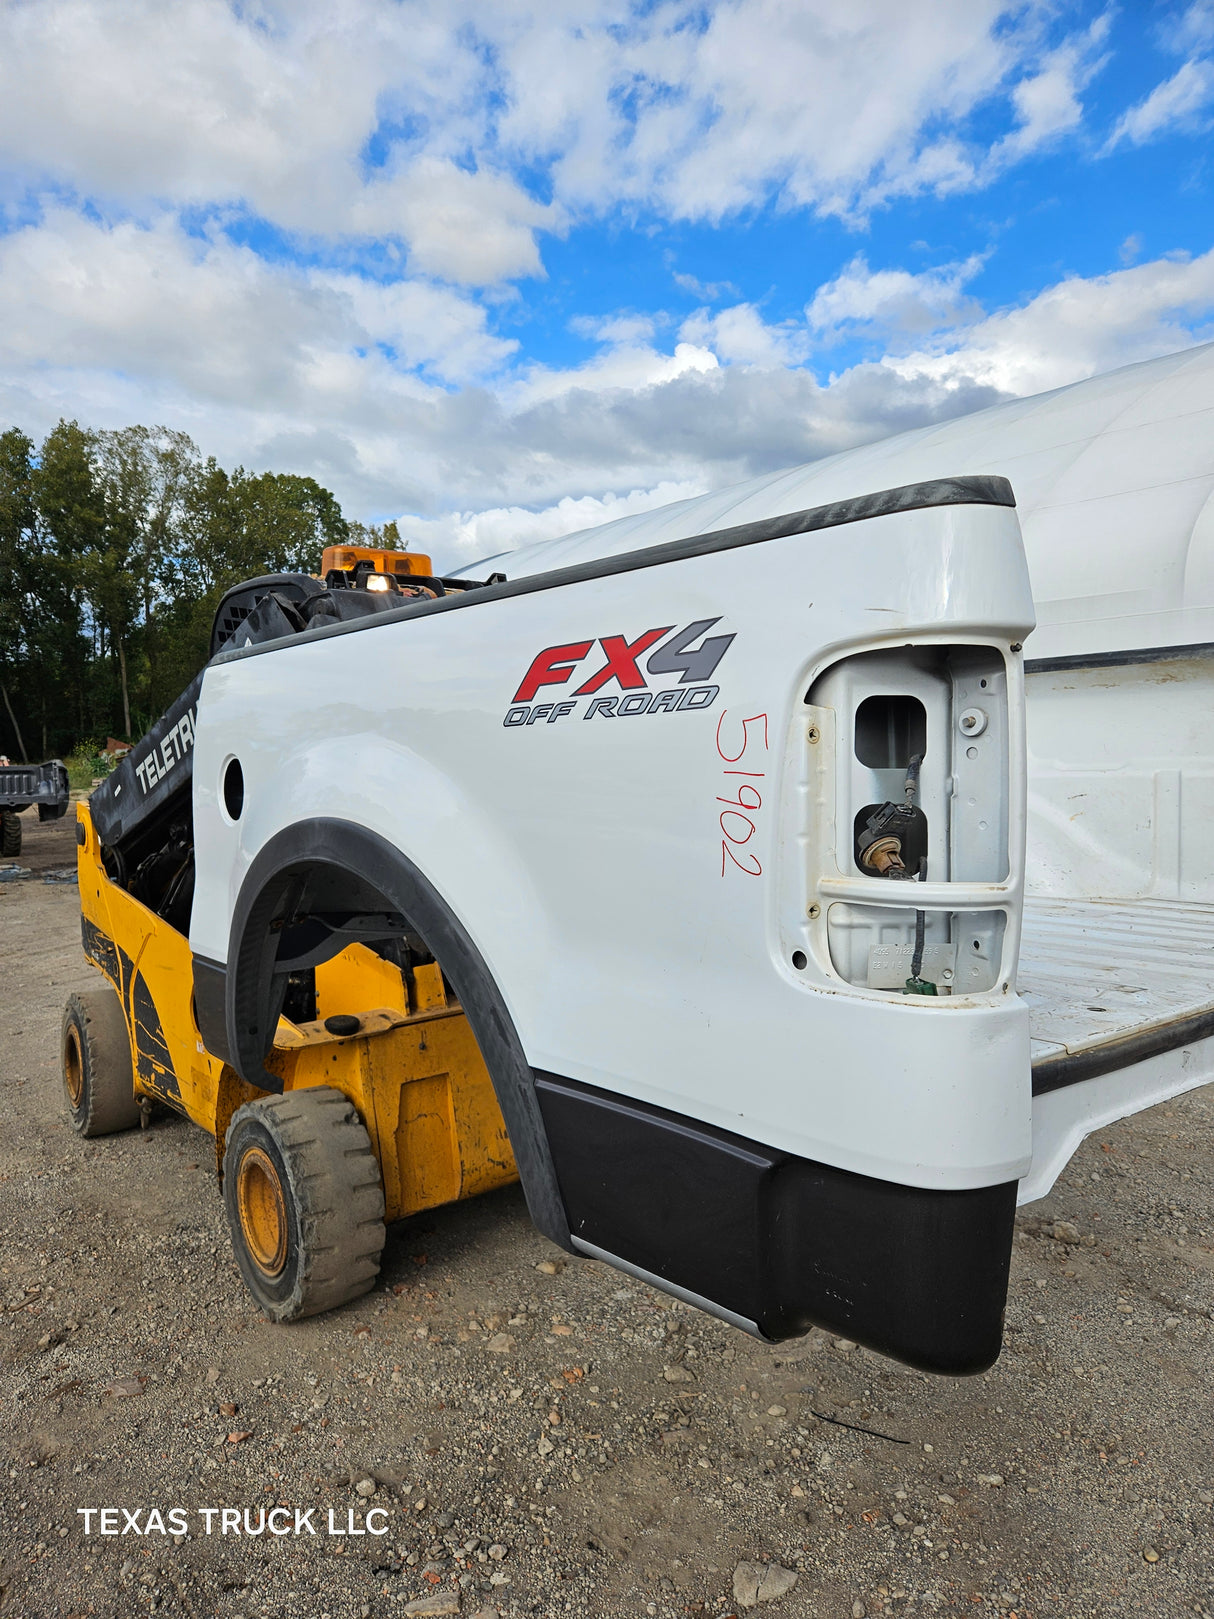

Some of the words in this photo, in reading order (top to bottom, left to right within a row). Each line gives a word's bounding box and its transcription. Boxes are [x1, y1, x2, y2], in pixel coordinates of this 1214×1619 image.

[511, 616, 738, 704] FX4
[503, 700, 577, 727] OFF
[583, 685, 720, 720] ROAD
[716, 709, 769, 878] 51902
